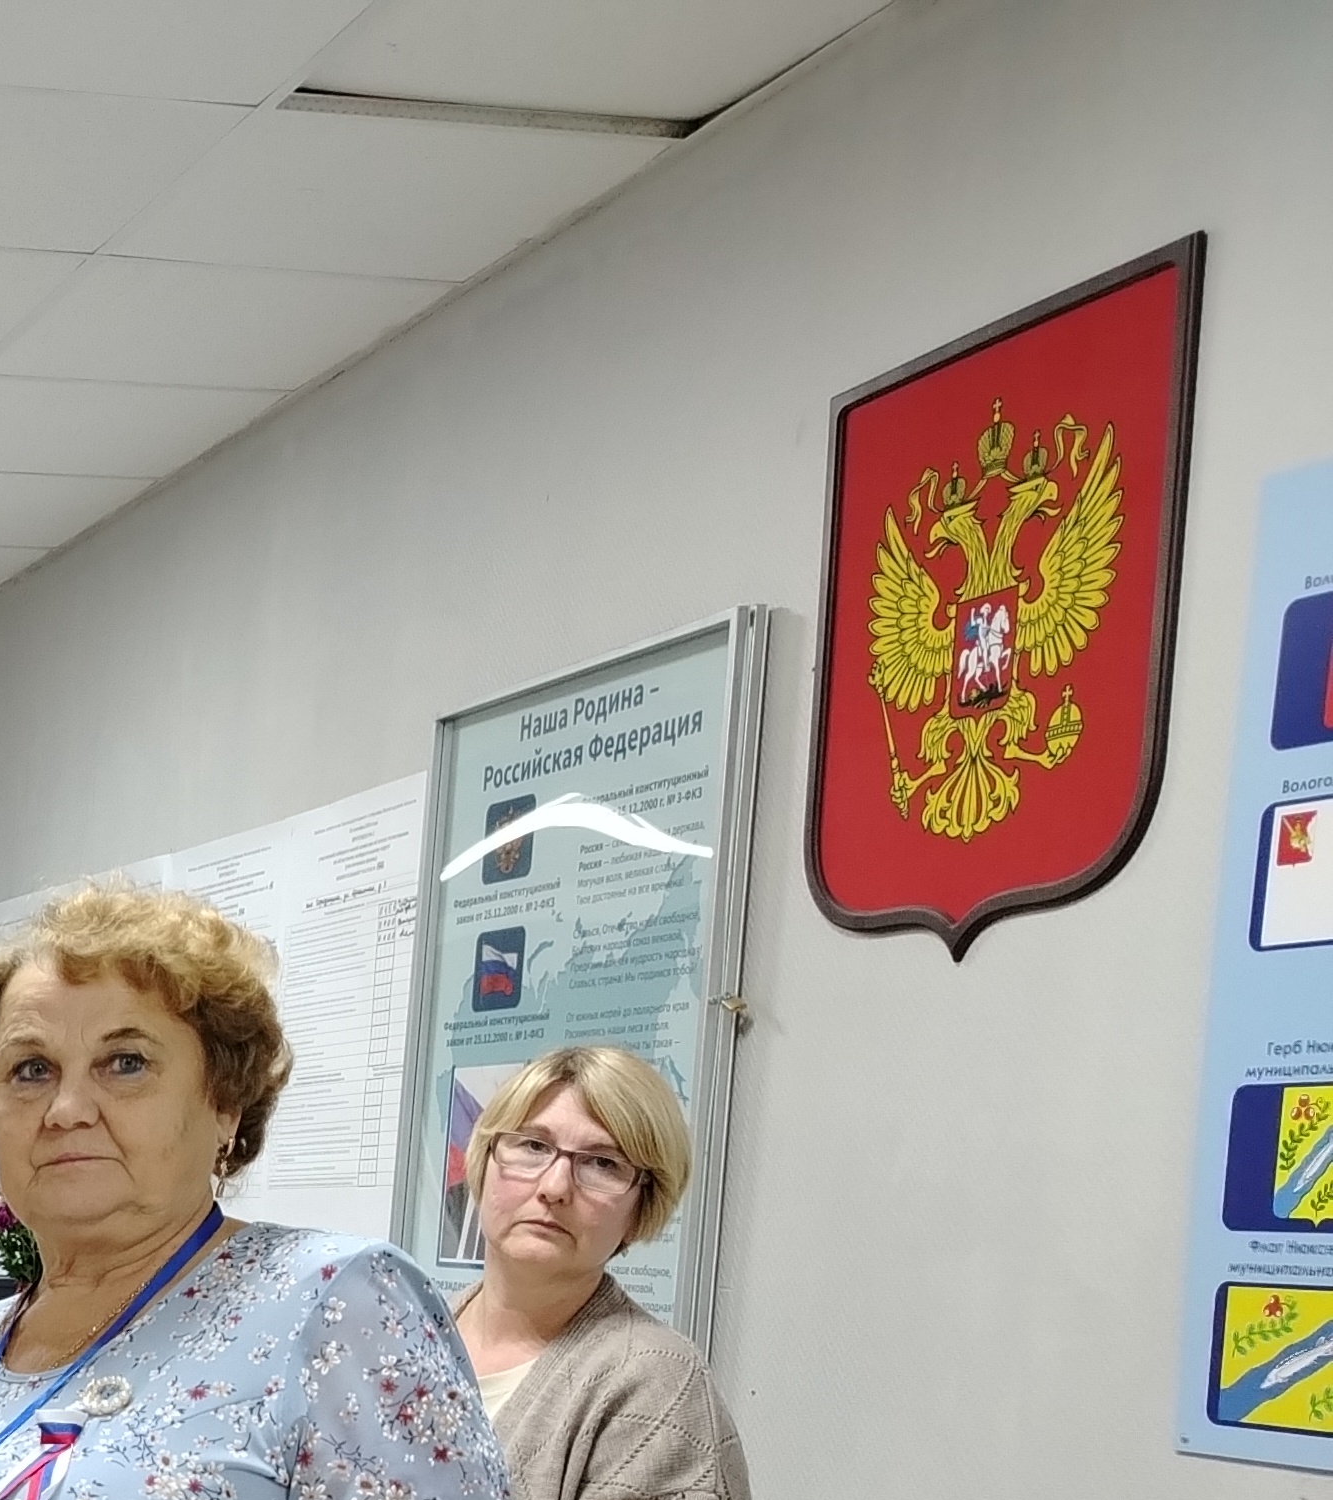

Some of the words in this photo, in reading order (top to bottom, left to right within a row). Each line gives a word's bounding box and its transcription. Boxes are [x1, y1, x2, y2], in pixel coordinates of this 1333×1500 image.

[520, 708, 568, 742] Наша
[573, 684, 644, 726] Родина
[483, 745, 584, 792] Российская
[588, 710, 703, 762] Федерация
[635, 764, 709, 790] конституционный
[1267, 1040, 1302, 1059] Герб
